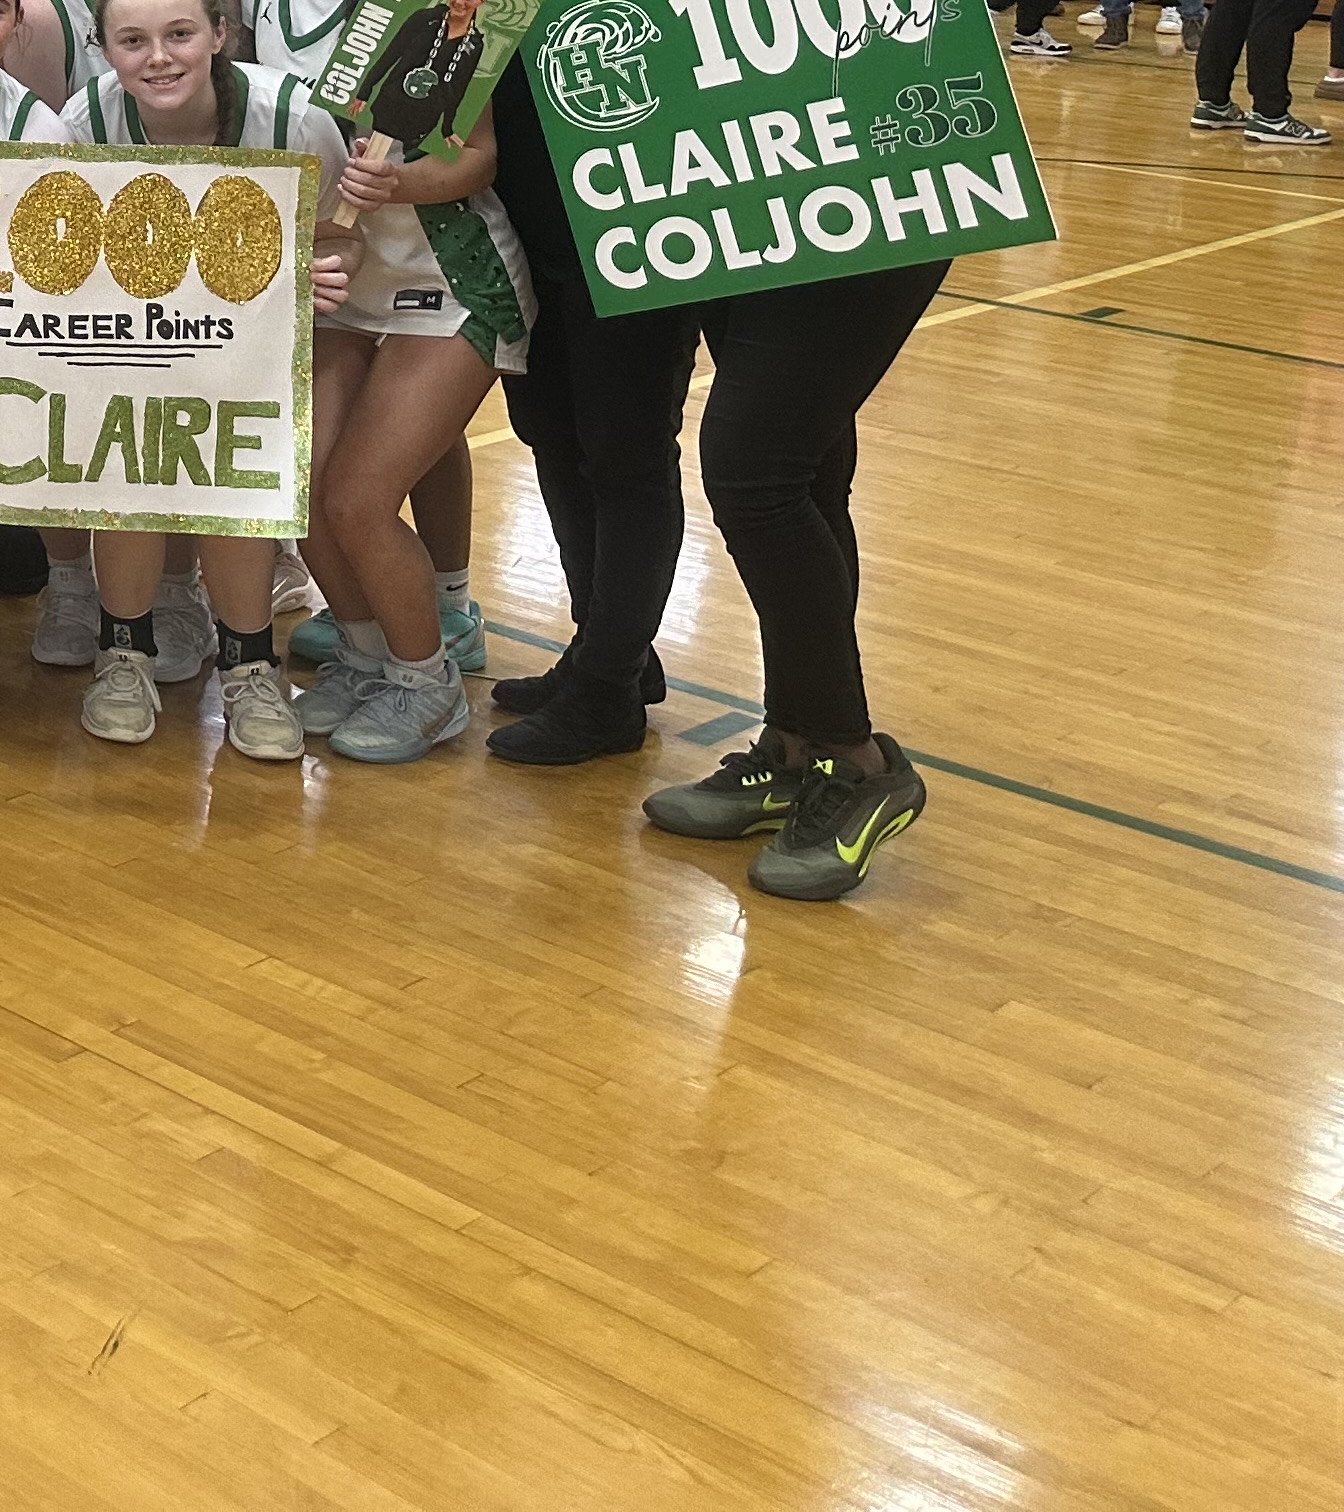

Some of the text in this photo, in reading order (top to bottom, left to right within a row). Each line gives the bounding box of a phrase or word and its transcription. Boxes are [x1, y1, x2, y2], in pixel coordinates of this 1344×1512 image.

[319, 1, 394, 106] COLJOHN
[572, 72, 998, 211] CLAIRE #35
[594, 153, 1029, 290] COLJOHN
